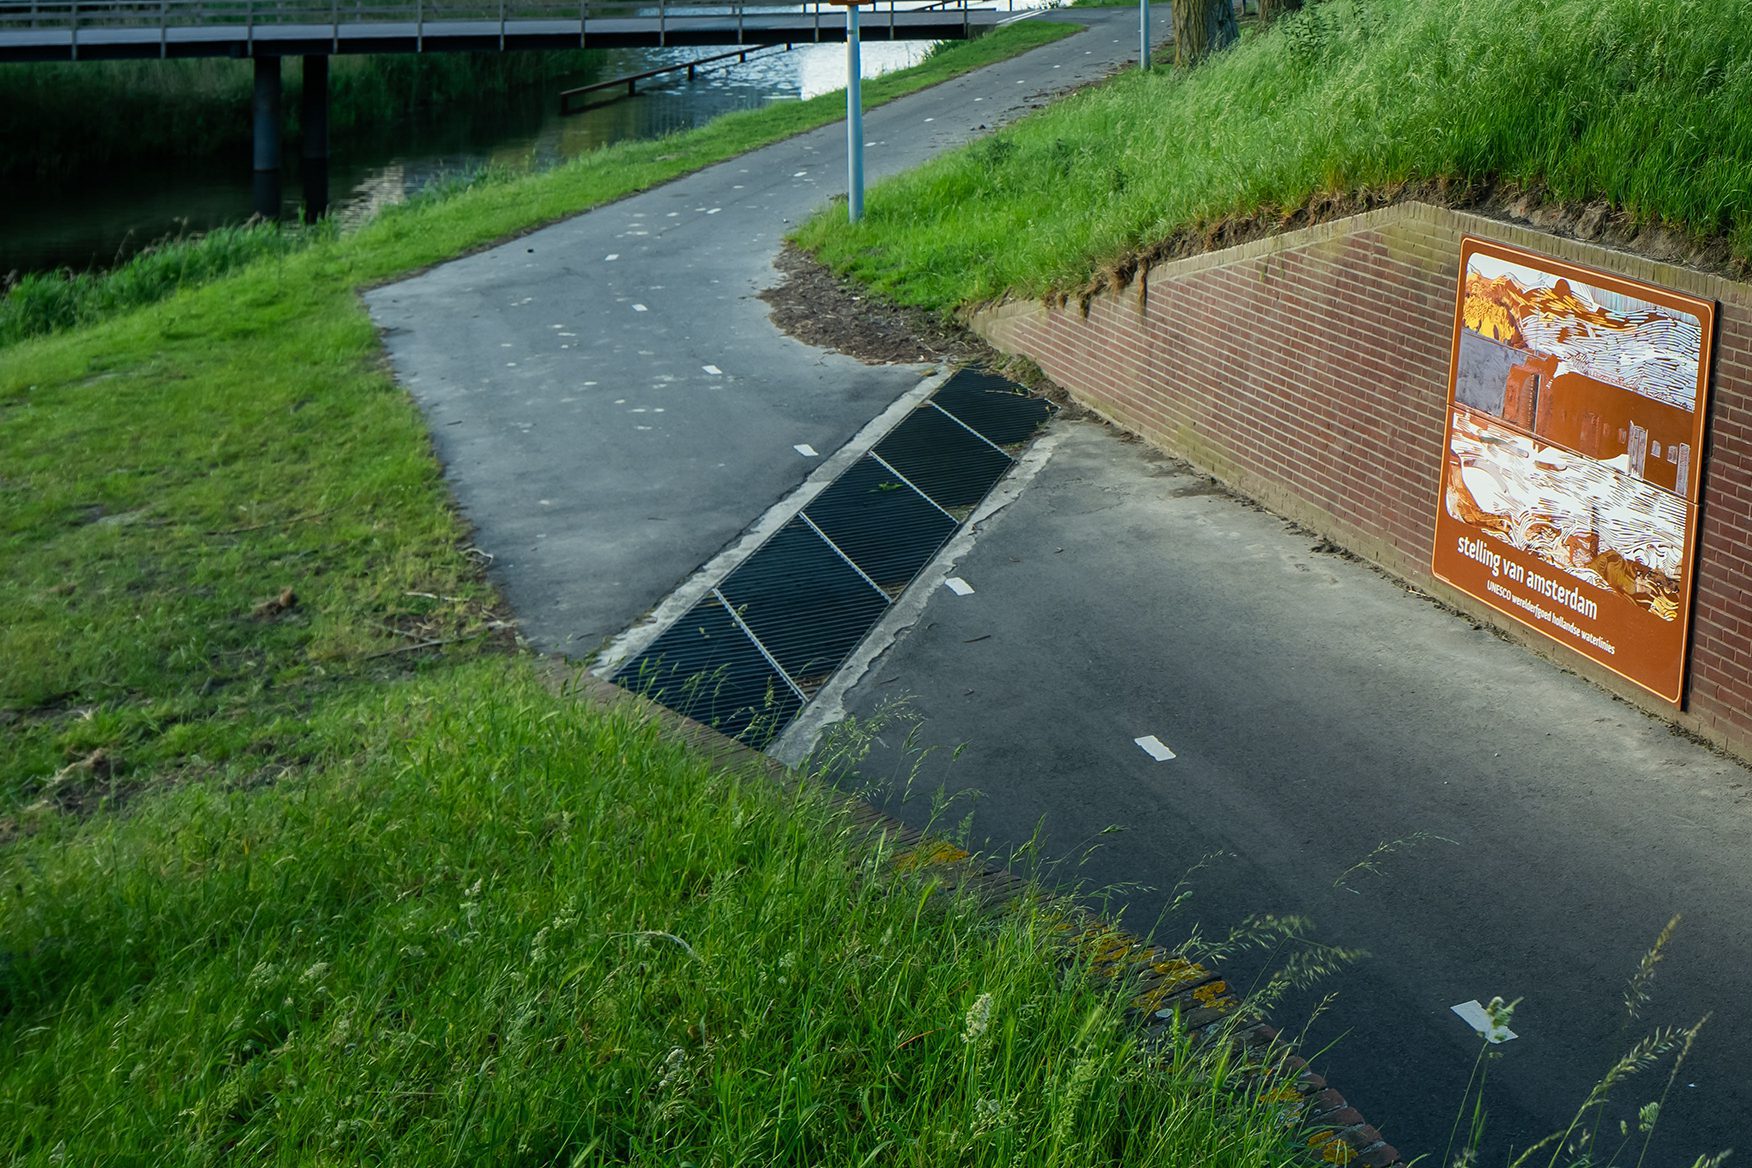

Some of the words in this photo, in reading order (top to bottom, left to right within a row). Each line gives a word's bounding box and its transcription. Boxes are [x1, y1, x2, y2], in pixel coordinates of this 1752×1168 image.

[1457, 536, 1501, 577] stelling
[1502, 558, 1525, 584] van
[1526, 570, 1598, 620] amsterdam
[1486, 580, 1512, 600] UNESCO
[1511, 594, 1552, 621] werelderfgoed
[1552, 612, 1581, 637] hollandse
[1581, 629, 1616, 655] waterlinies
